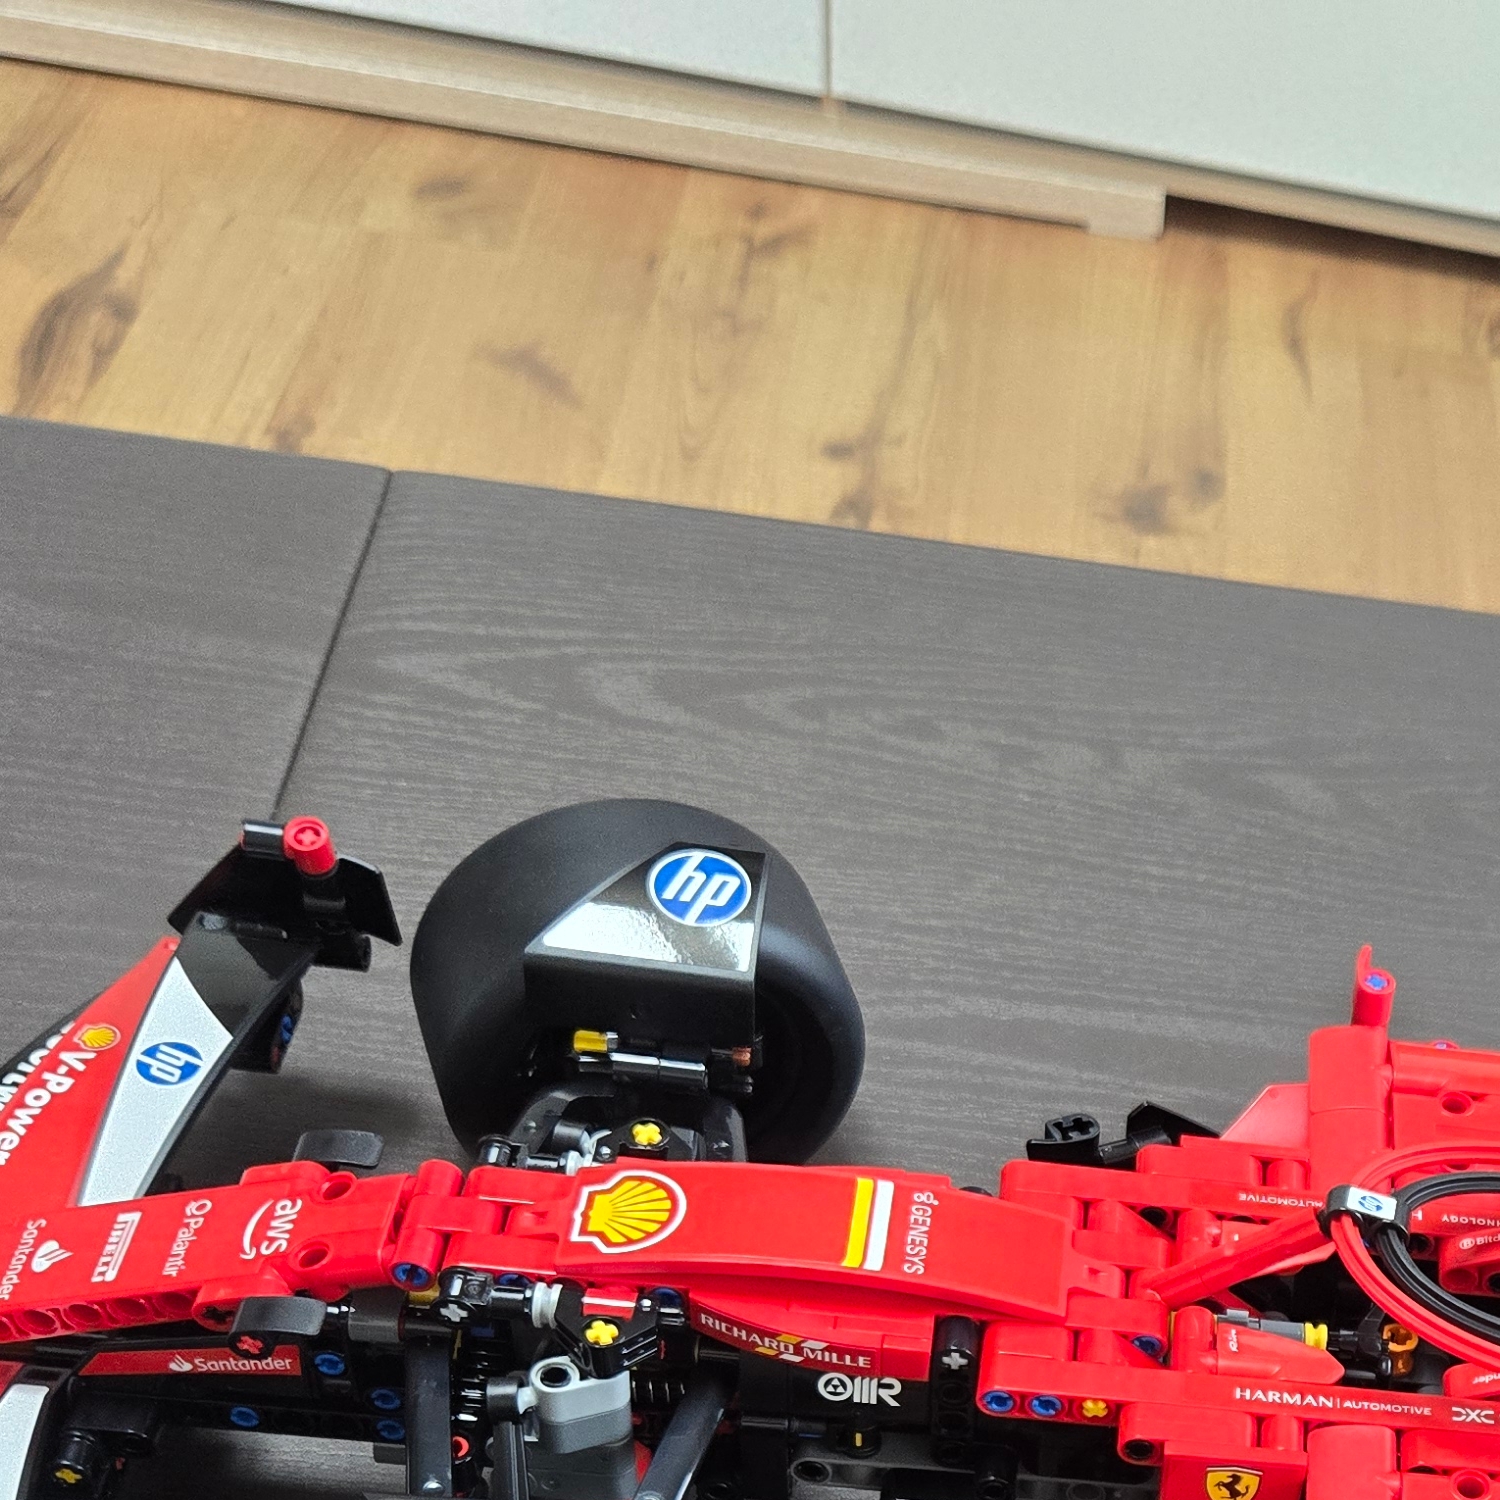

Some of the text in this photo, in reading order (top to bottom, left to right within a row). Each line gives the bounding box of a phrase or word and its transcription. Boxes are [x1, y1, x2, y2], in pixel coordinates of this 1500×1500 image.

[660, 851, 741, 924] hp
[138, 1042, 205, 1084] hp
[162, 1217, 205, 1278] Palantir
[259, 1199, 303, 1256] aws
[903, 1204, 933, 1275] GENESYS
[0, 1218, 47, 1301] Santander
[194, 1356, 293, 1372] Santander
[700, 1313, 872, 1368] RICHARD MILLE
[1235, 1386, 1433, 1416] HARMAN AUTOMOTIVE
